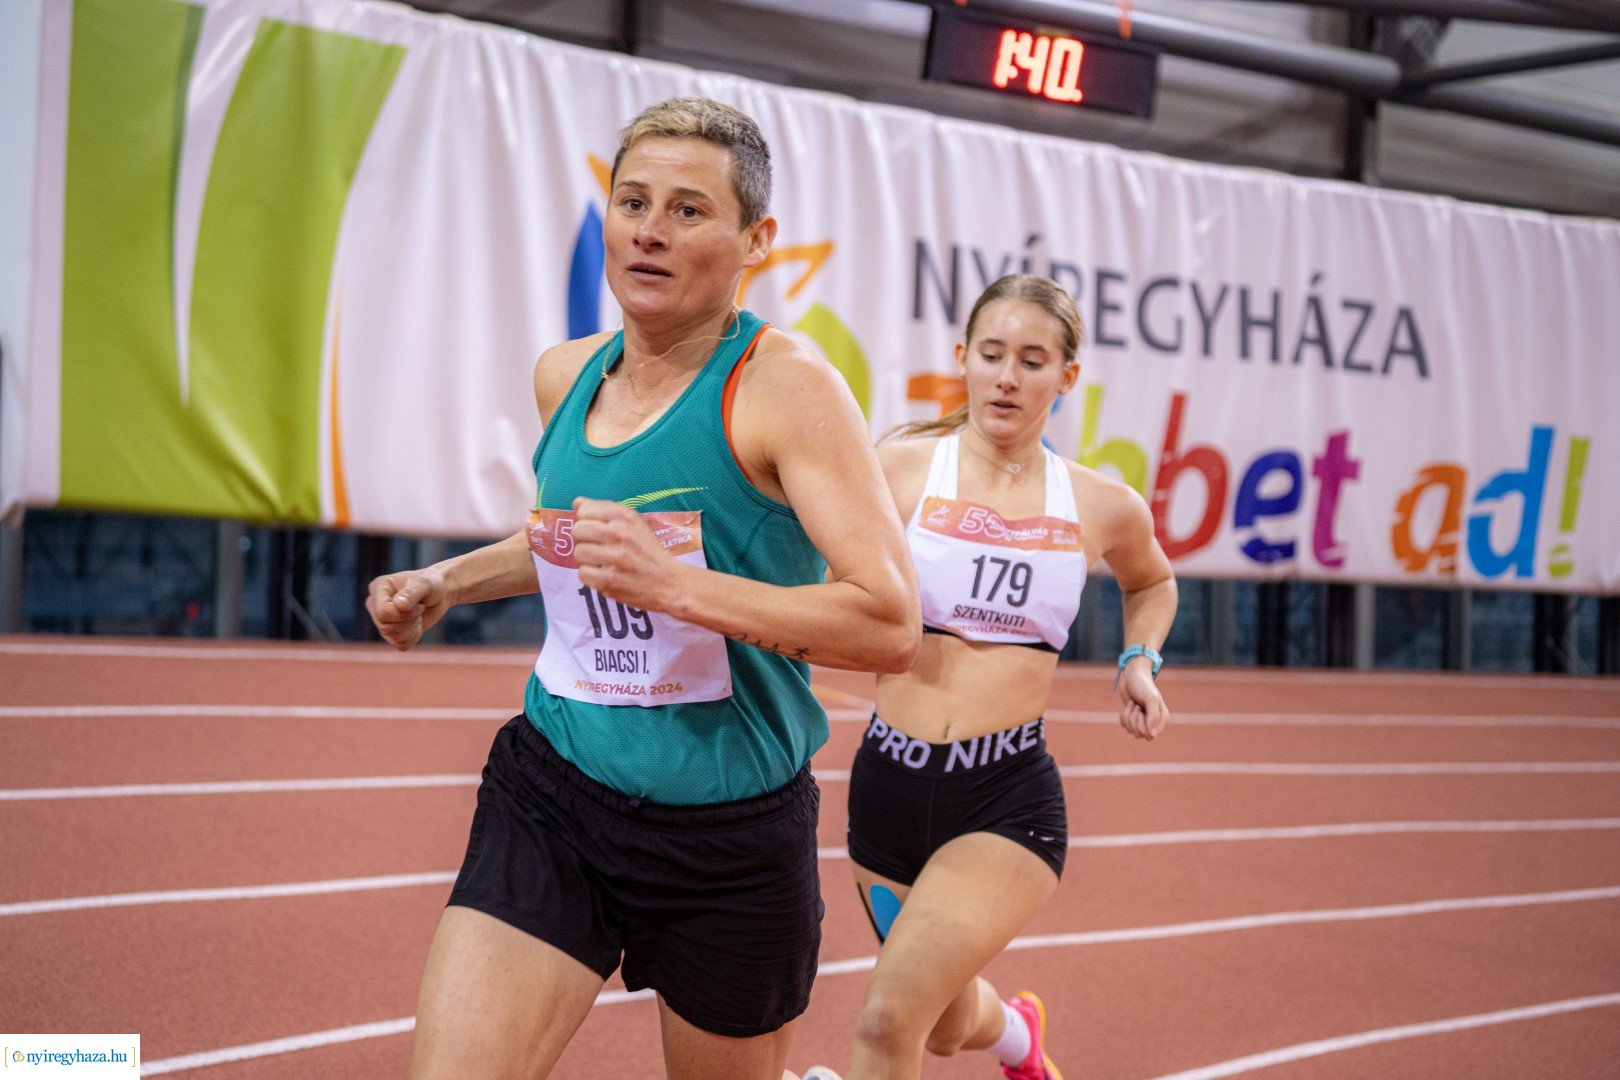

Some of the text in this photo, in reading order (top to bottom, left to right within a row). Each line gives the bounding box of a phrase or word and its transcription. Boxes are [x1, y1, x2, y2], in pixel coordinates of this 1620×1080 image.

[907, 373, 1590, 579] bbet ad!
[554, 518, 575, 556] 5
[970, 554, 1034, 609] 179
[578, 585, 654, 641] 109
[953, 603, 1027, 628] SZENTKUTI
[595, 648, 650, 674] BIACSI I.
[649, 682, 684, 695] 2024
[867, 716, 1039, 773] PRO NIKE
